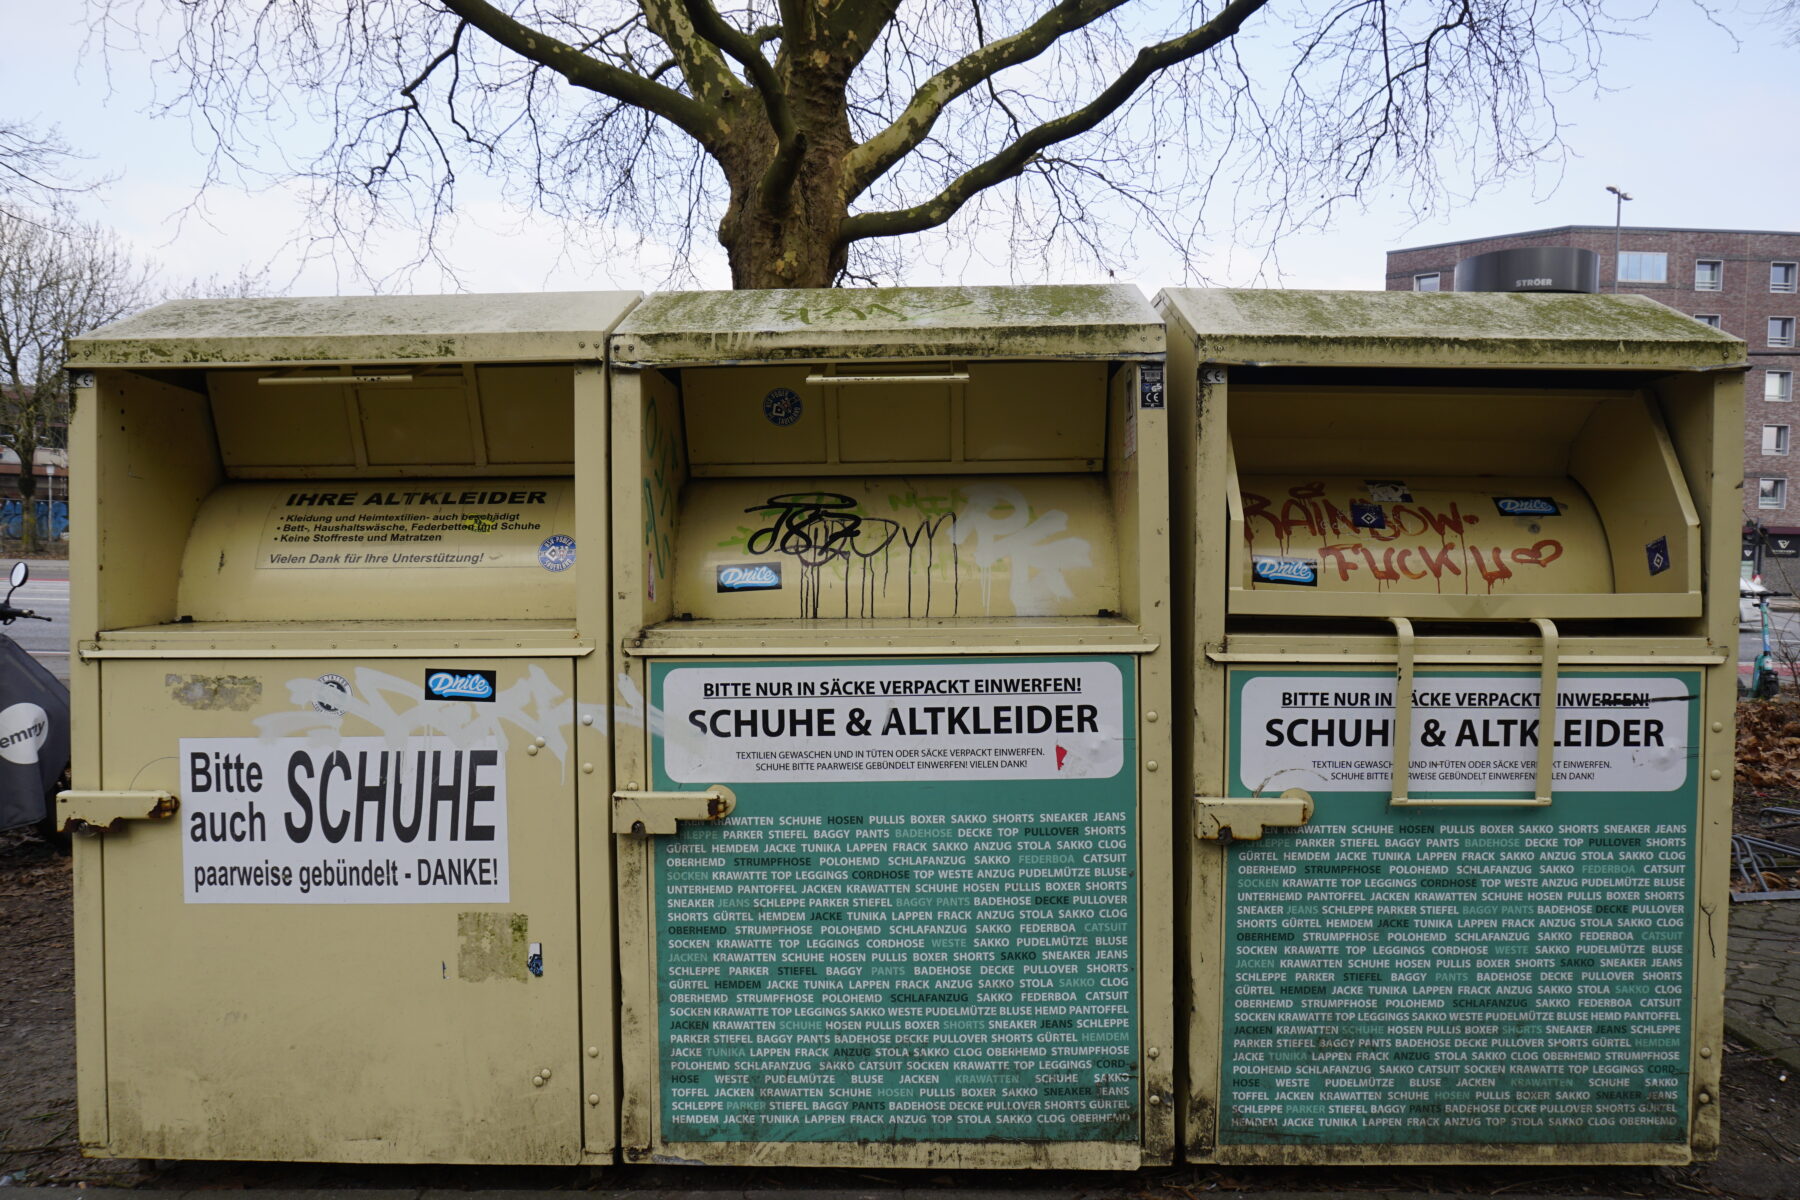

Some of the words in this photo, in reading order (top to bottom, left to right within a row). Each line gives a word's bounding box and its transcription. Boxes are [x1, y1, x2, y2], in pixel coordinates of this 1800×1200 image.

[1146, 392, 1159, 402] CE
[286, 492, 358, 506] IHRE
[363, 491, 547, 505] ALTKLEIDER
[285, 514, 333, 524] Kleidung
[335, 514, 356, 522] und
[357, 513, 430, 522] Heimtextilien-
[432, 513, 459, 521] auch
[282, 523, 310, 533] Bett-,
[313, 523, 408, 532] Haushaltswäsche,
[500, 522, 541, 530] Schuhe
[279, 533, 310, 542] Keine
[312, 533, 364, 542] Stoffreste
[366, 533, 388, 542] und
[389, 532, 442, 542] Matratzen
[269, 553, 306, 564] Vielen
[308, 553, 341, 564] Dank
[343, 553, 363, 563] für
[364, 553, 389, 563] Ihre
[391, 552, 484, 565] Unterstützung!
[1318, 543, 1461, 582] FUCK
[703, 682, 751, 698] BITTE
[755, 681, 792, 698] NUR
[797, 681, 815, 697] IN
[819, 678, 875, 697] SÄCKE
[879, 679, 969, 696] VERPACKT
[974, 677, 1081, 695] EINWERFEN!
[1281, 692, 1328, 708] BITTE
[1334, 692, 1371, 708] NUR
[1375, 692, 1392, 707] IN
[1455, 692, 1540, 708] VERPACKT
[688, 708, 836, 738] SCHUHE
[845, 707, 872, 737] &
[880, 704, 1098, 735] ALTKLEIDER
[1265, 718, 1396, 747] SCHUH
[1420, 718, 1447, 747] &
[735, 751, 777, 760] TEXTILIEN
[778, 750, 832, 759] GEWASCHEN
[833, 750, 854, 759] UND
[854, 750, 864, 758] IN
[865, 749, 894, 758] TÜTEN
[895, 749, 920, 758] ODER
[920, 748, 948, 757] SÄCKE
[949, 748, 993, 757] VERPACKT
[993, 747, 1045, 756] EINWERFEN.
[755, 762, 791, 771] SCHUHE
[791, 762, 815, 771] BITTE
[816, 761, 864, 770] PAARWEISE
[865, 761, 915, 770] GEBÜNDELT
[916, 760, 968, 769] EINWERFEN!
[969, 760, 999, 768] VIELEN
[1000, 759, 1028, 768] DANK!
[1311, 760, 1352, 769] TEXTILIEN
[1353, 760, 1393, 769] GEWASCH
[1408, 760, 1427, 769] UND
[1429, 760, 1438, 769] IN
[1440, 759, 1466, 769] TÜTEN
[1467, 760, 1491, 769] ODER
[1492, 759, 1519, 769] SÄCKE
[1562, 760, 1612, 769] EINWERFEN.
[190, 751, 263, 793] Bitte
[1330, 772, 1365, 780] SCHUHE
[1366, 772, 1389, 780] BITTE
[1438, 771, 1487, 780] GEBÜNDELT
[1568, 772, 1595, 780] DANK!
[284, 750, 498, 843] SCHUHE
[190, 801, 266, 842] auch
[665, 857, 726, 867] OBERHEMD
[734, 857, 811, 867] STRUMPFHOSE
[819, 856, 880, 866] POLOHEMD
[887, 855, 966, 866] SCHLAFANZUG
[973, 855, 1011, 864] SAKKO
[1018, 854, 1075, 864] FEDERBOA
[1082, 853, 1127, 863] CATSUIT
[194, 859, 293, 892] paarweise
[298, 858, 398, 892] gebündelt
[417, 857, 497, 886] DANKE!
[1237, 865, 1297, 874] OBERHEMD
[1304, 865, 1381, 874] STRUMPFHOSE
[1388, 865, 1449, 874] POLOHEMD
[1456, 865, 1532, 874] SCHLAFANZUG
[1538, 864, 1575, 874] SAKKO
[1582, 864, 1635, 874] FEDERBOA
[1643, 864, 1686, 874] CATSUIT
[666, 884, 733, 894] UNTERHEMD
[737, 884, 797, 894] PANTOFFEL
[801, 884, 842, 894] JACKEN
[846, 883, 911, 893] KRAWATTEN
[914, 883, 959, 893] SCHUHE
[962, 882, 1000, 892] HOSEN
[1004, 882, 1041, 892] PULLIS
[1045, 881, 1081, 891] BOXER
[1084, 881, 1128, 891] SHORTS
[667, 939, 710, 949] SOCKEN
[716, 939, 773, 949] KRAWATTE
[778, 939, 800, 948] TOP
[806, 939, 860, 949] LEGGINGS
[865, 938, 925, 948] CORDHOSE
[931, 938, 966, 948] WESTE
[972, 937, 1010, 947] SAKKO
[1016, 935, 1089, 947] PUDELMÜTZE
[1094, 935, 1128, 946] BLUSE
[1235, 945, 1278, 955] SOCKEN
[1283, 945, 1340, 955] KRAWATTE
[1344, 945, 1367, 955] TOP
[1372, 945, 1426, 955] LEGGINGS
[1431, 945, 1489, 955] CORDHOSE
[1494, 945, 1528, 954] WESTE
[1534, 945, 1570, 954] SAKKO
[1575, 943, 1646, 954] PUDELMÜTZE
[1651, 944, 1683, 954] BLUSE
[668, 993, 729, 1003] OBERHEMD
[735, 993, 814, 1003] STRUMPFHOSE
[821, 993, 883, 1003] POLOHEMD
[890, 993, 968, 1002] SCHLAFANZUG
[976, 992, 1013, 1002] SAKKO
[1020, 991, 1077, 1002] FEDERBOA
[1084, 990, 1128, 1001] CATSUIT
[1234, 999, 1294, 1008] OBERHEMD
[1300, 999, 1378, 1008] STRUMPFHOSE
[1385, 999, 1445, 1008] POLOHEMD
[1453, 998, 1527, 1008] SCHLAFANZUG
[1535, 998, 1571, 1007] SAKKO
[1577, 998, 1633, 1007] FEDERBOA
[1639, 998, 1682, 1007] CATSUIT
